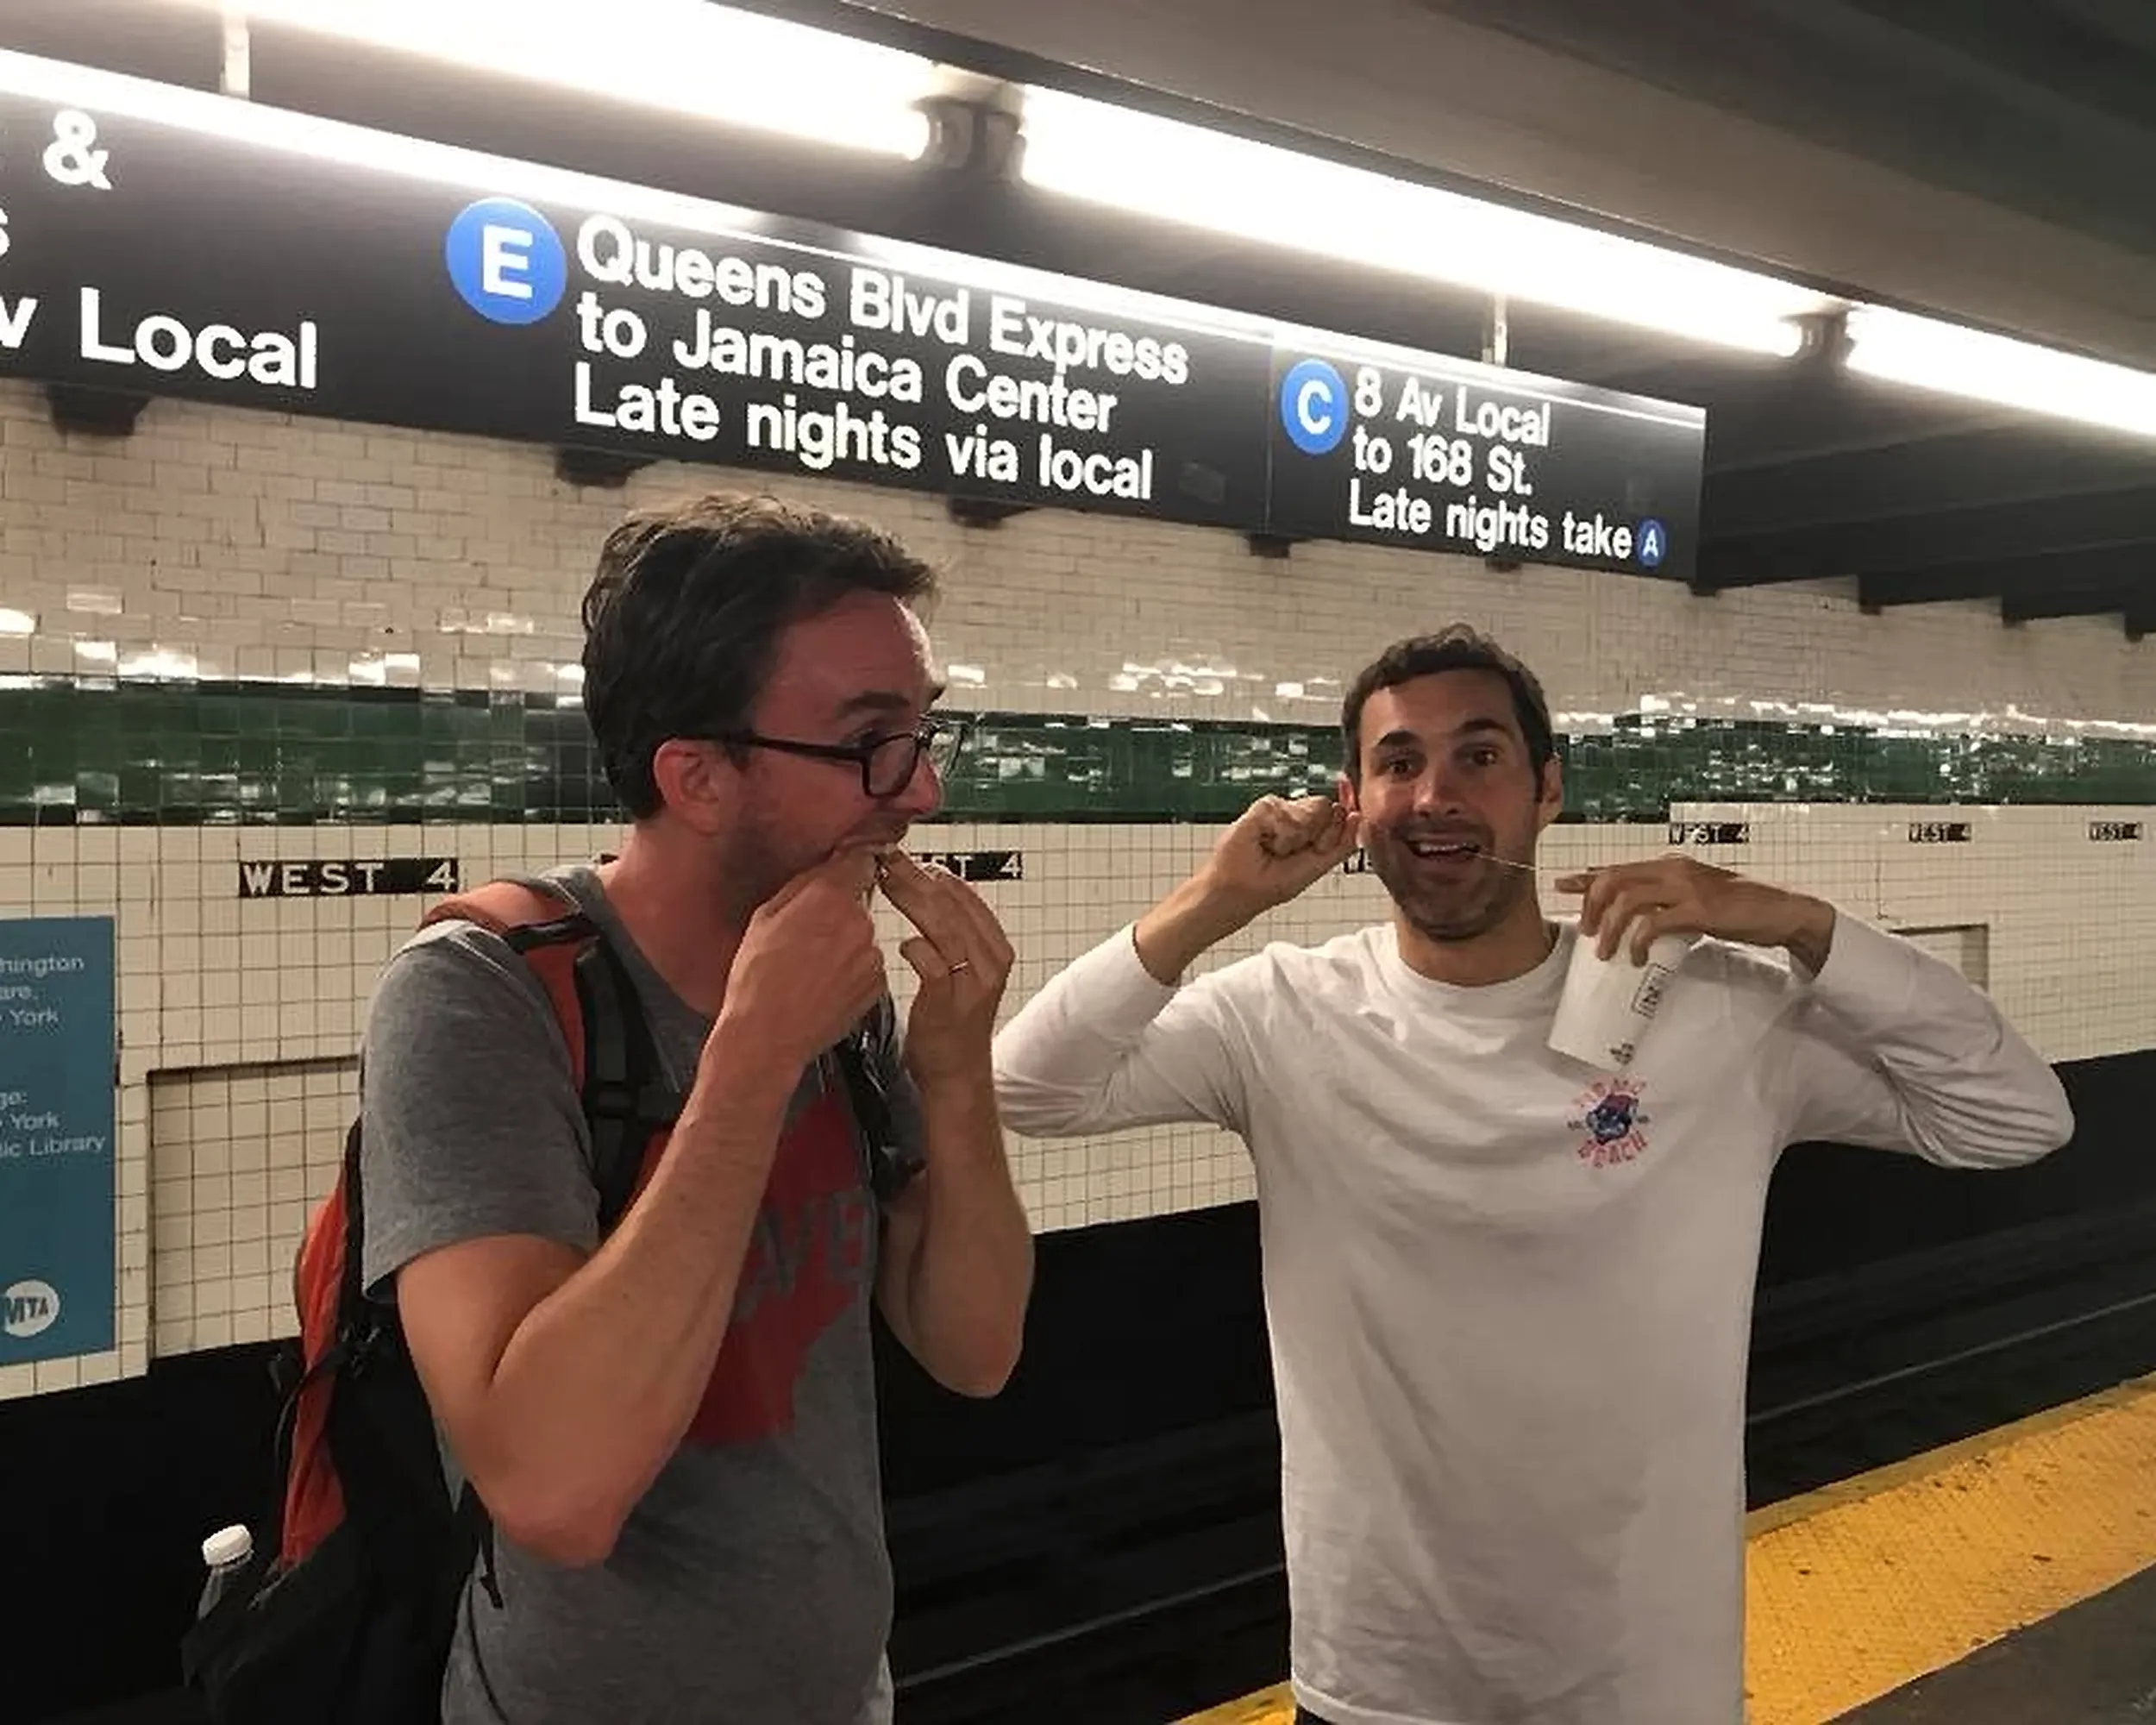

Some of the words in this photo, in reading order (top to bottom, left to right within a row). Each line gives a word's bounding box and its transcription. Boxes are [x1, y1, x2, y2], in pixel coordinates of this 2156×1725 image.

[44, 110, 111, 190] &
[482, 224, 533, 298] E
[577, 214, 825, 319] Queens
[850, 267, 969, 345] Blvd
[990, 295, 1188, 385] Express
[81, 287, 317, 389] Local
[577, 292, 647, 358] to
[673, 308, 923, 404] Jamaica
[946, 354, 1117, 432] Center
[575, 361, 721, 441] Late
[747, 394, 921, 470] nights
[945, 424, 1018, 483] via
[1040, 434, 1153, 499] local
[1297, 380, 1331, 434] C
[1354, 367, 1381, 417] 8
[1396, 377, 1443, 427] Av
[1457, 386, 1551, 447] Local
[1352, 426, 1392, 473] to
[1408, 433, 1471, 486] 168
[1488, 444, 1532, 495] St.
[1350, 479, 1431, 534] Late
[1447, 494, 1548, 551] nights
[1563, 511, 1632, 559] take
[1642, 533, 1658, 557] A
[243, 862, 385, 895] WEST
[427, 861, 455, 890] 4
[1000, 854, 1021, 878] 4
[9, 1007, 59, 1026] York
[9, 1111, 60, 1131] York
[30, 1136, 105, 1156] Library
